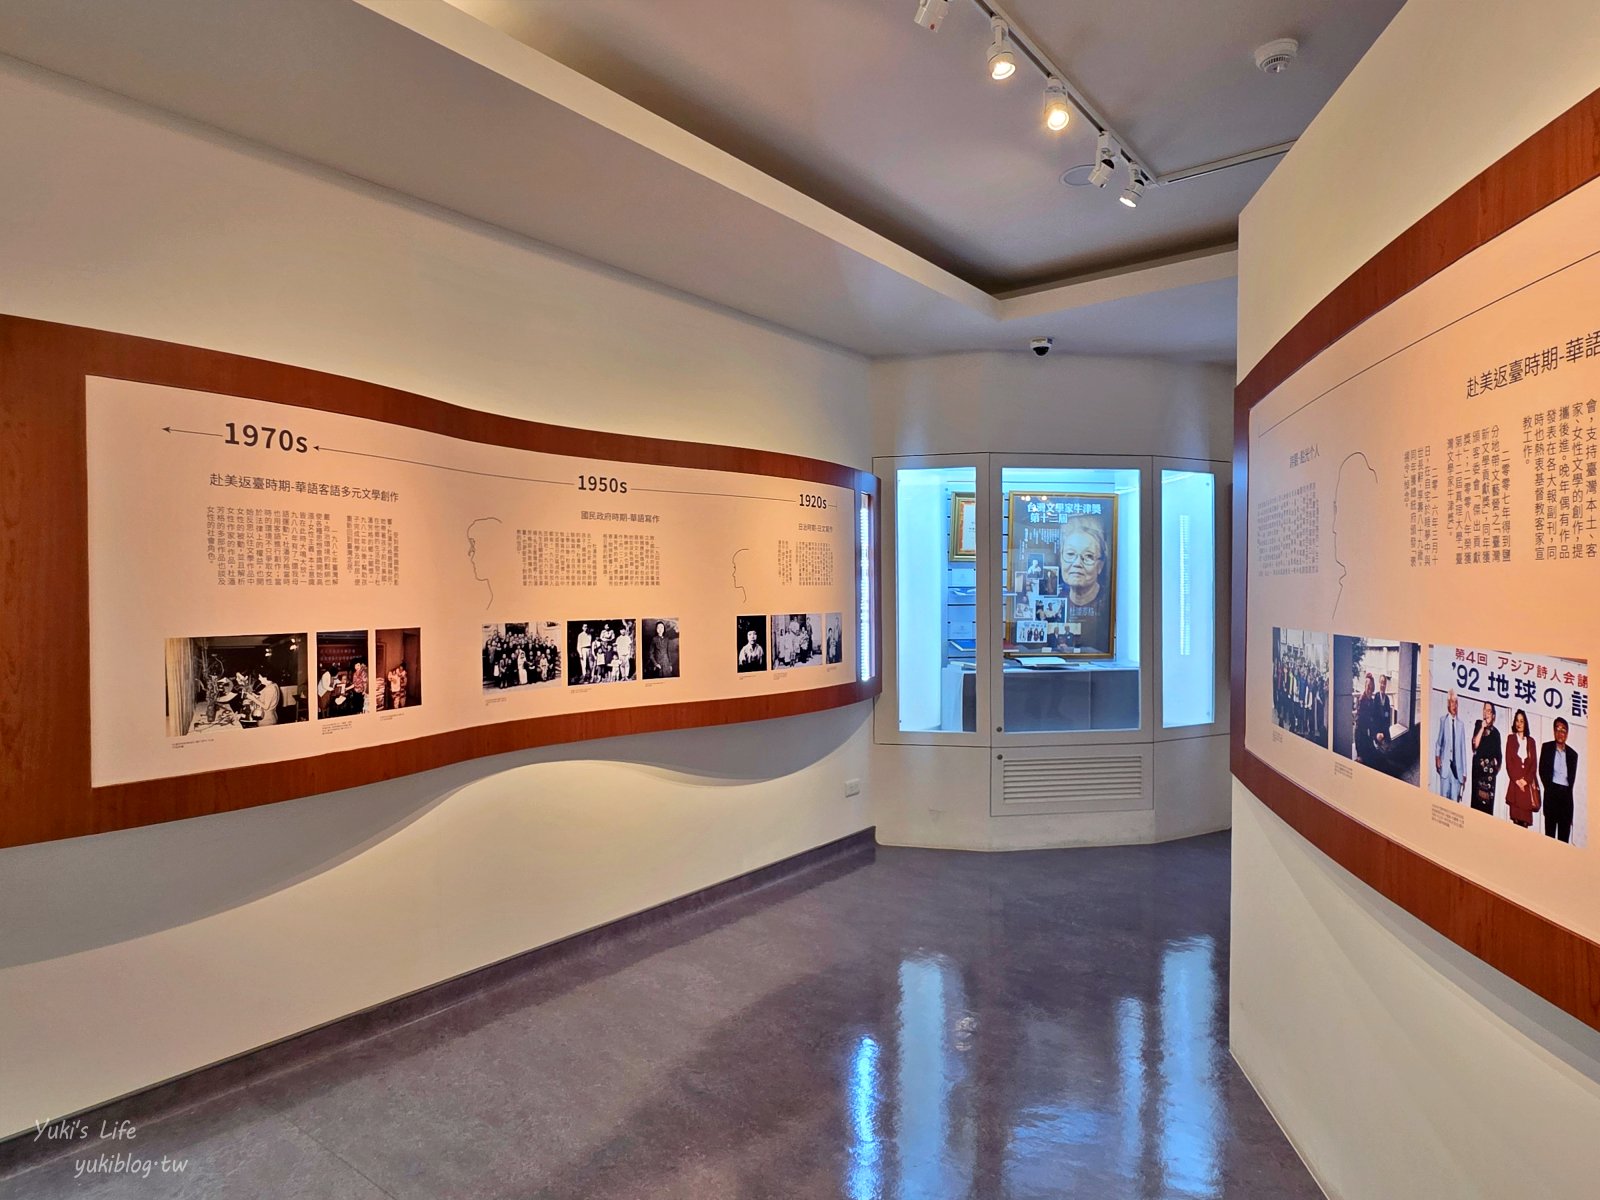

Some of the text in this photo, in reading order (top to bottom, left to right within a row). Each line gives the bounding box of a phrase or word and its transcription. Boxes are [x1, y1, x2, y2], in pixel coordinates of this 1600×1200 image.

[225, 422, 308, 454] 1970s
[1522, 414, 1532, 465] 教工作。
[209, 473, 399, 502] 赴美返臺時期-華語客語多元文學創作
[578, 475, 628, 494] 1950s
[799, 494, 827, 509] 1920s
[1027, 502, 1102, 514] 台灣文學家牛津獎
[580, 511, 660, 524] 國民政府時期-華語寫作
[1455, 648, 1488, 666] 第4回
